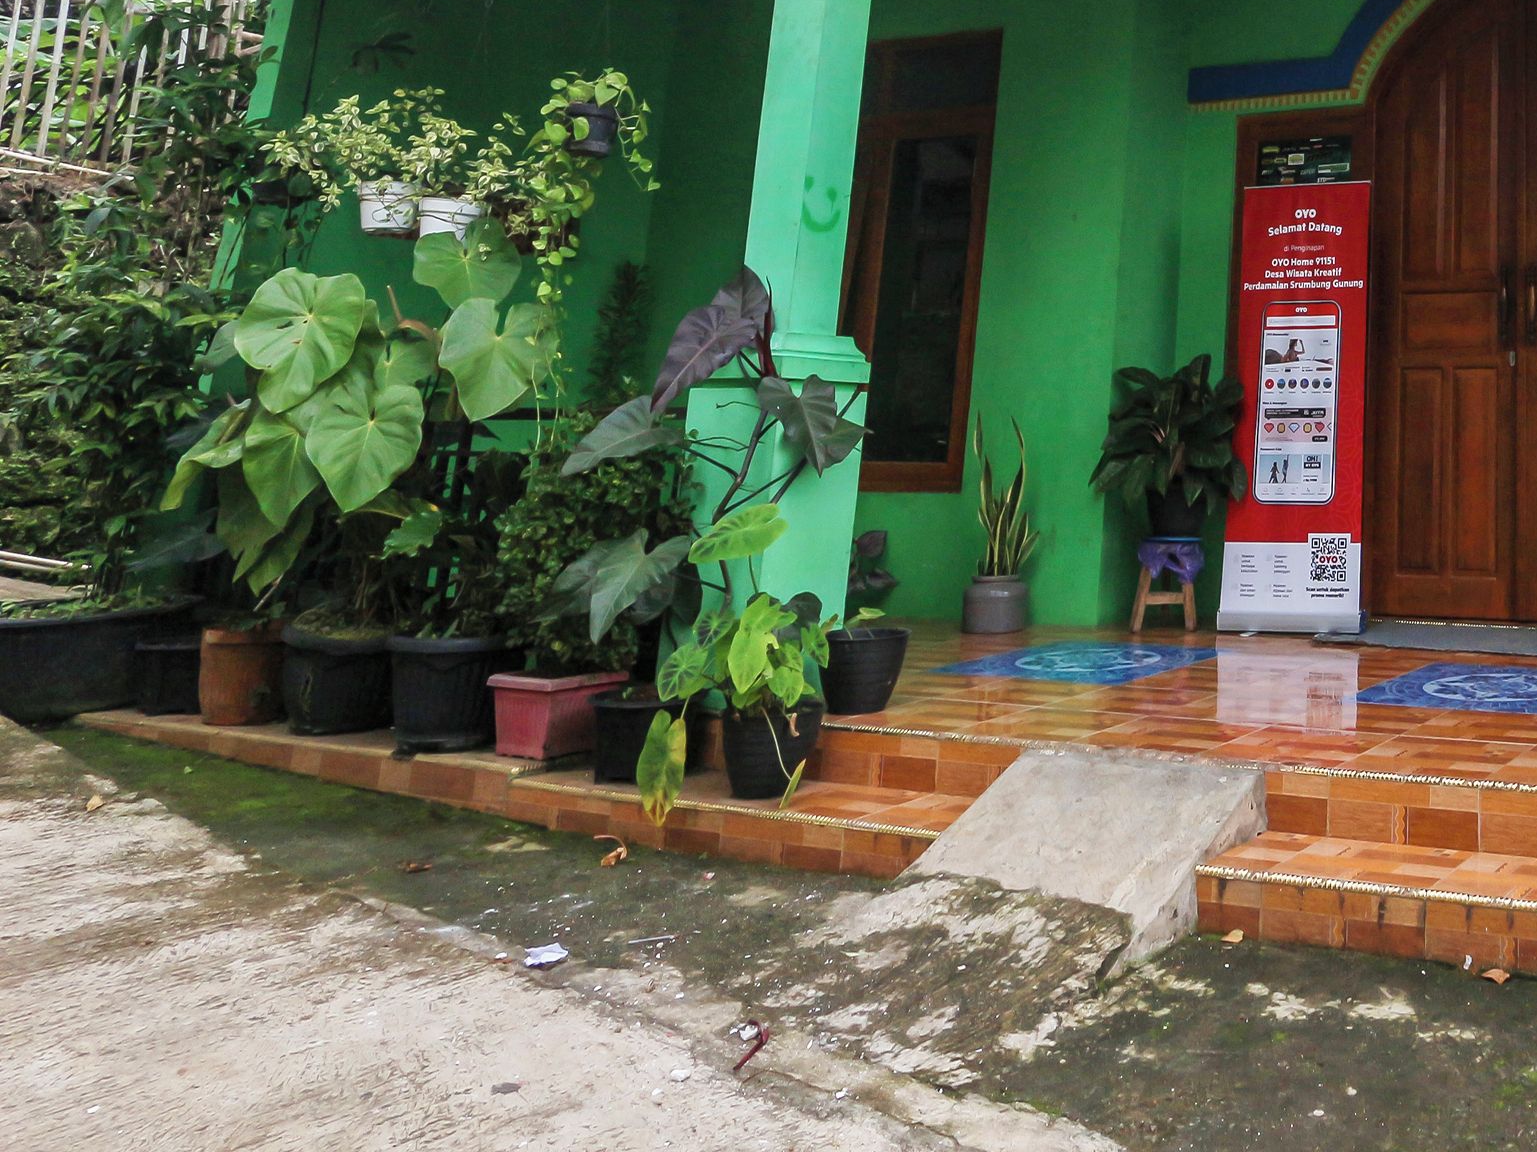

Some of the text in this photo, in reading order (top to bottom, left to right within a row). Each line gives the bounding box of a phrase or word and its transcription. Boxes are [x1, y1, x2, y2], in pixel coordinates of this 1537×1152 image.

[1295, 209, 1316, 219] OYO
[1268, 222, 1343, 236] Selamat Datang
[1271, 256, 1336, 267] OYO Home 91151
[1265, 267, 1342, 278] Desa Wisata Kreatif
[1290, 280, 1331, 290] Srumbung
[1332, 279, 1364, 289] Gunung
[1319, 555, 1338, 564] OYO
